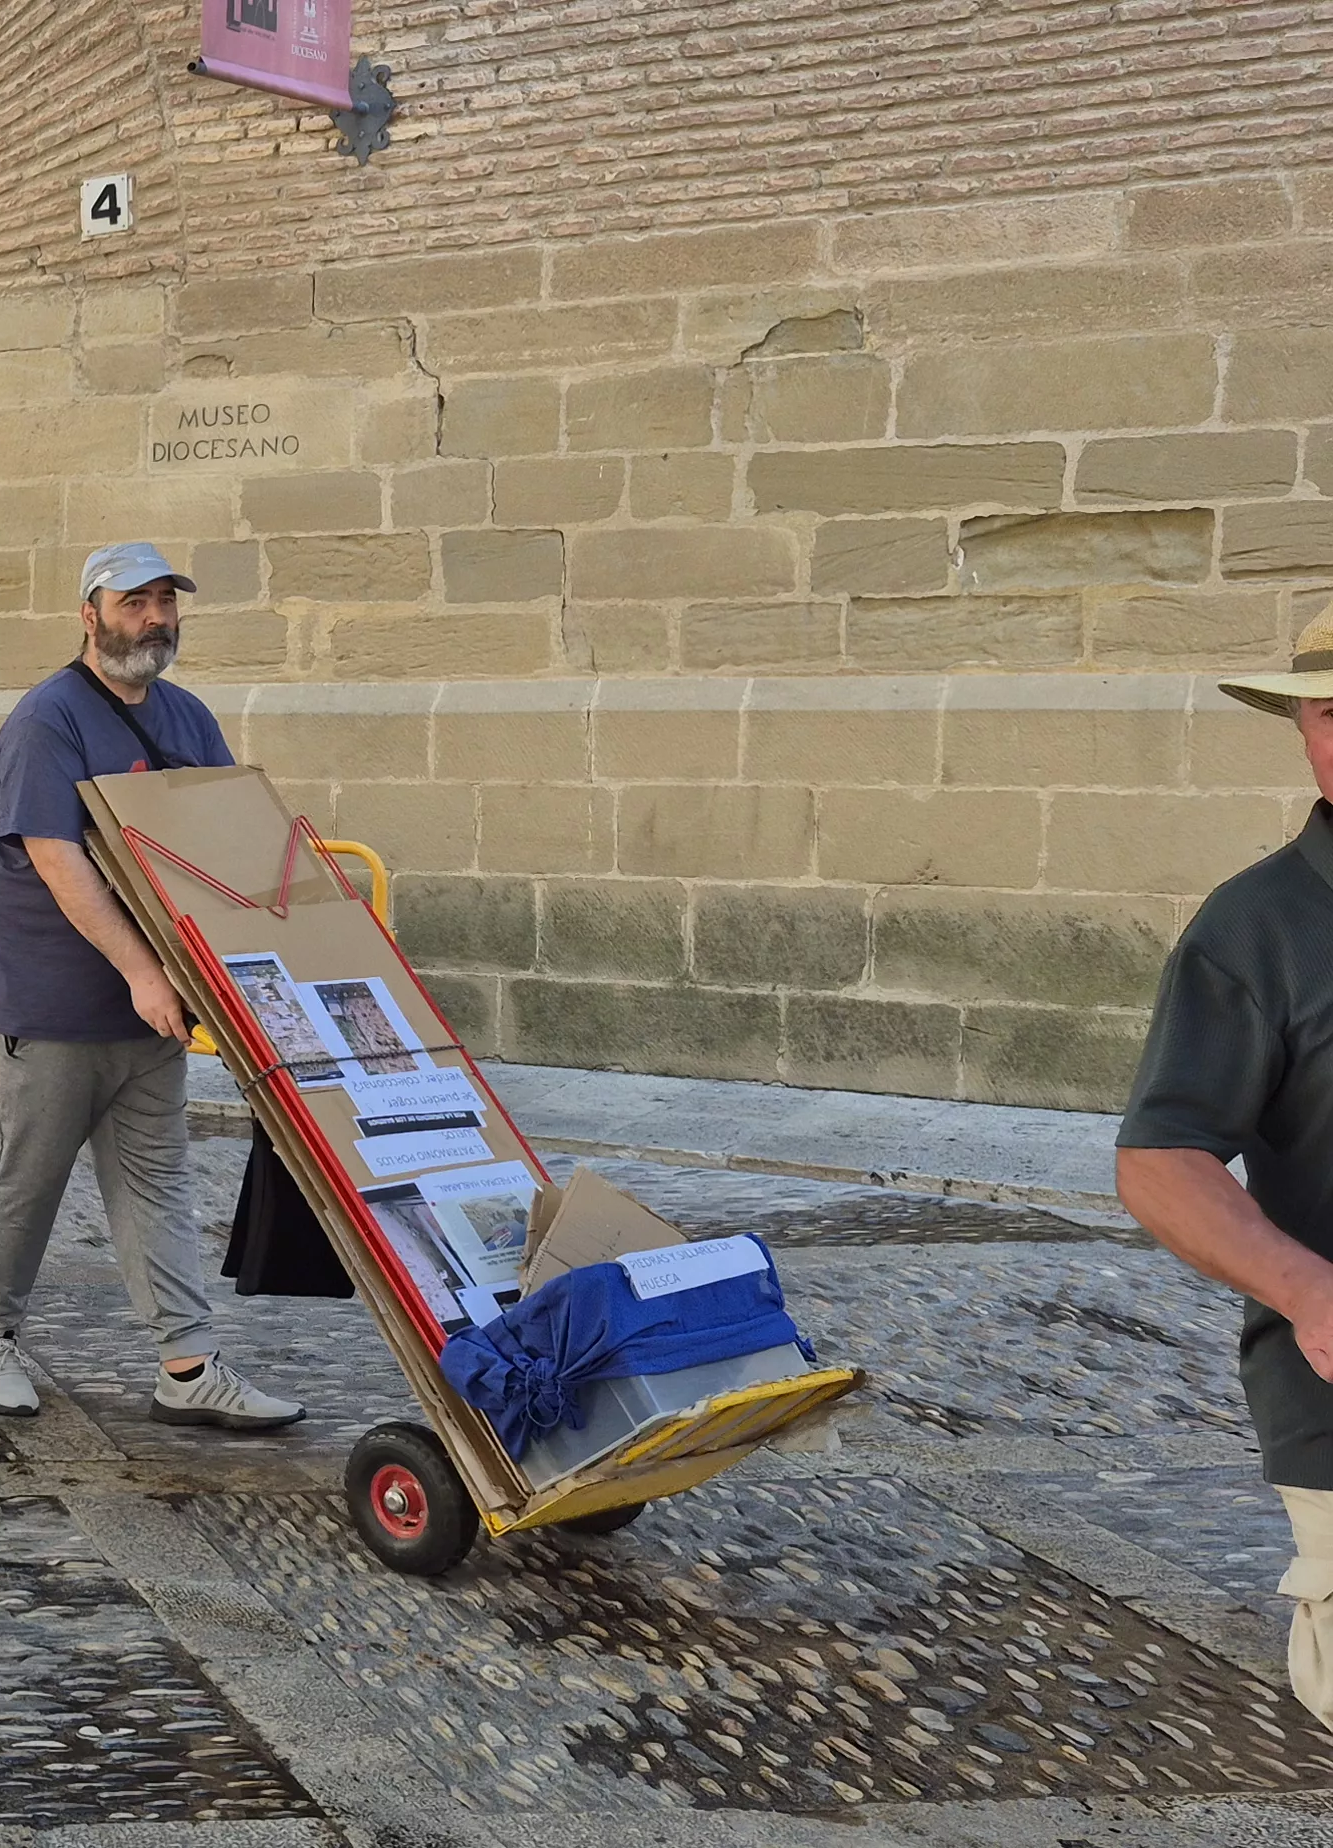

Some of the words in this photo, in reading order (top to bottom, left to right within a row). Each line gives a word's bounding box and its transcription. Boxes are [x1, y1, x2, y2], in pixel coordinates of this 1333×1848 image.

[291, 44, 327, 62] DIOCESANO
[91, 183, 121, 225] 4
[178, 403, 271, 430] MUSEO
[152, 435, 300, 463] DIOCESANO
[421, 1071, 463, 1084] vender,
[419, 1091, 460, 1106] pueden
[416, 1146, 478, 1160] PATRIMONIO
[478, 1145, 487, 1155] EL
[375, 1156, 396, 1167] LOS
[397, 1154, 416, 1164] POR
[627, 1252, 669, 1270] PIEDRAS
[669, 1252, 677, 1262] Y
[678, 1245, 719, 1261] SILLARES
[718, 1241, 735, 1251] DE
[639, 1272, 682, 1293] HUESCA
